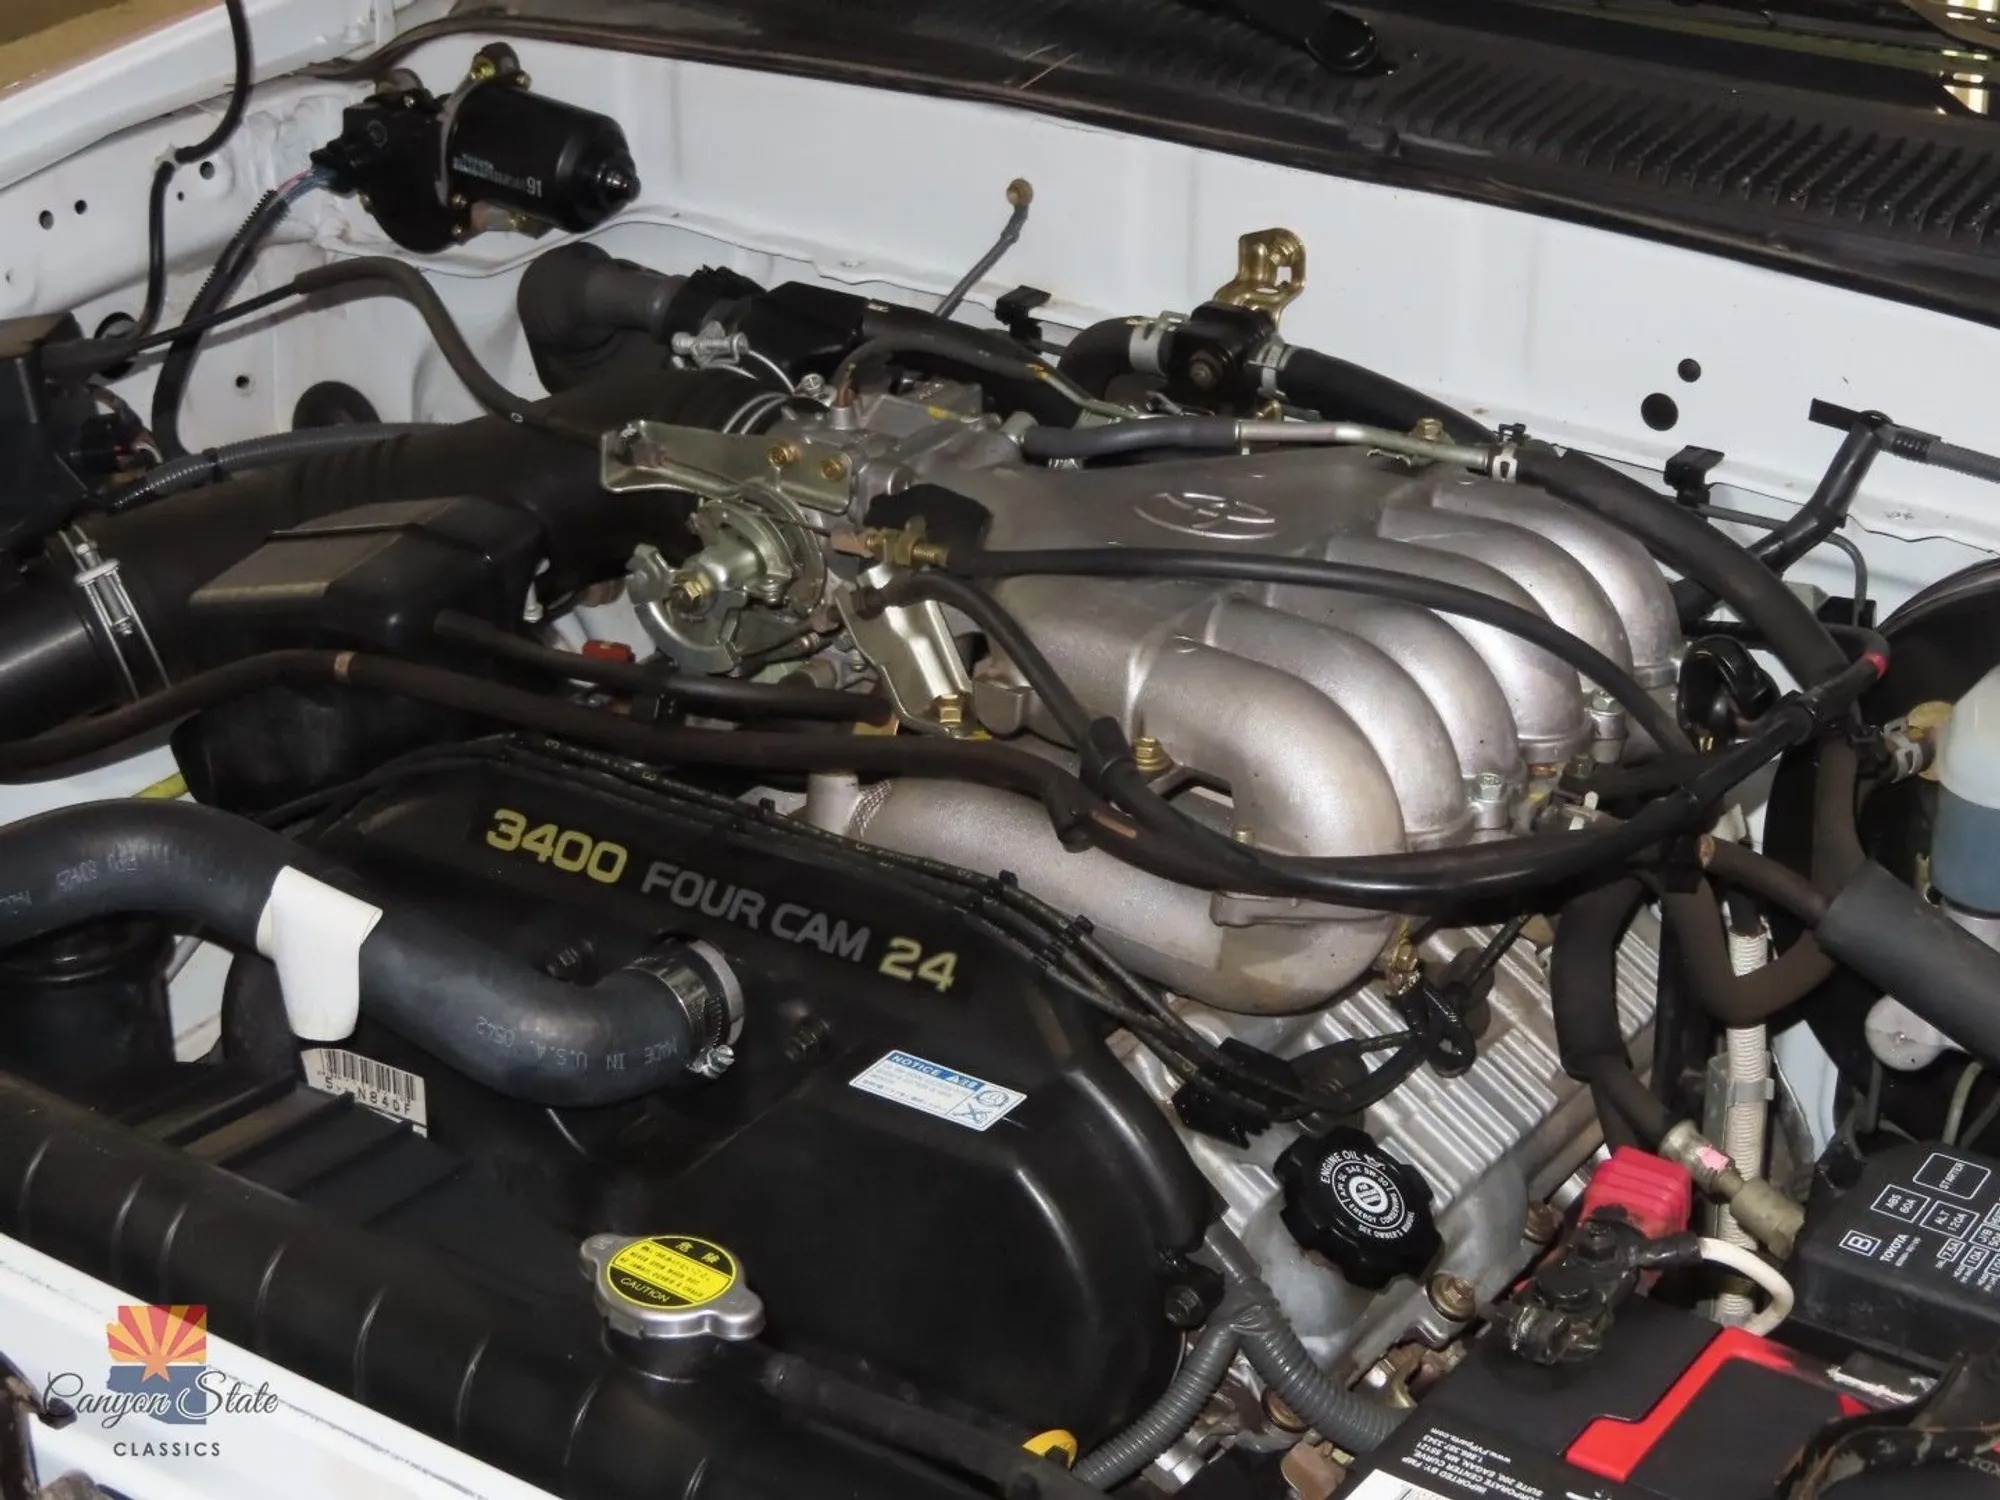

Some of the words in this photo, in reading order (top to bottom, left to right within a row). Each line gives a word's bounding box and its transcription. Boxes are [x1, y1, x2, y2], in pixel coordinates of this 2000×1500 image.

[486, 809, 628, 884] 3400
[640, 861, 766, 929] FOUR
[770, 903, 871, 962] CAM
[878, 936, 958, 993] 24
[606, 1052, 626, 1072] IN
[891, 1054, 941, 1077] NOTICE
[1320, 1152, 1342, 1184] ENGINE
[1342, 1150, 1361, 1162] OIL
[1938, 1161, 1965, 1190] STARTER
[1885, 1193, 1902, 1209] ABS
[1934, 1209, 1950, 1225] ALT
[1947, 1213, 1968, 1232] 120A
[1847, 1235, 1872, 1251] B
[1879, 1234, 1910, 1262] TOYOTA
[620, 1277, 670, 1303] CAUTION
